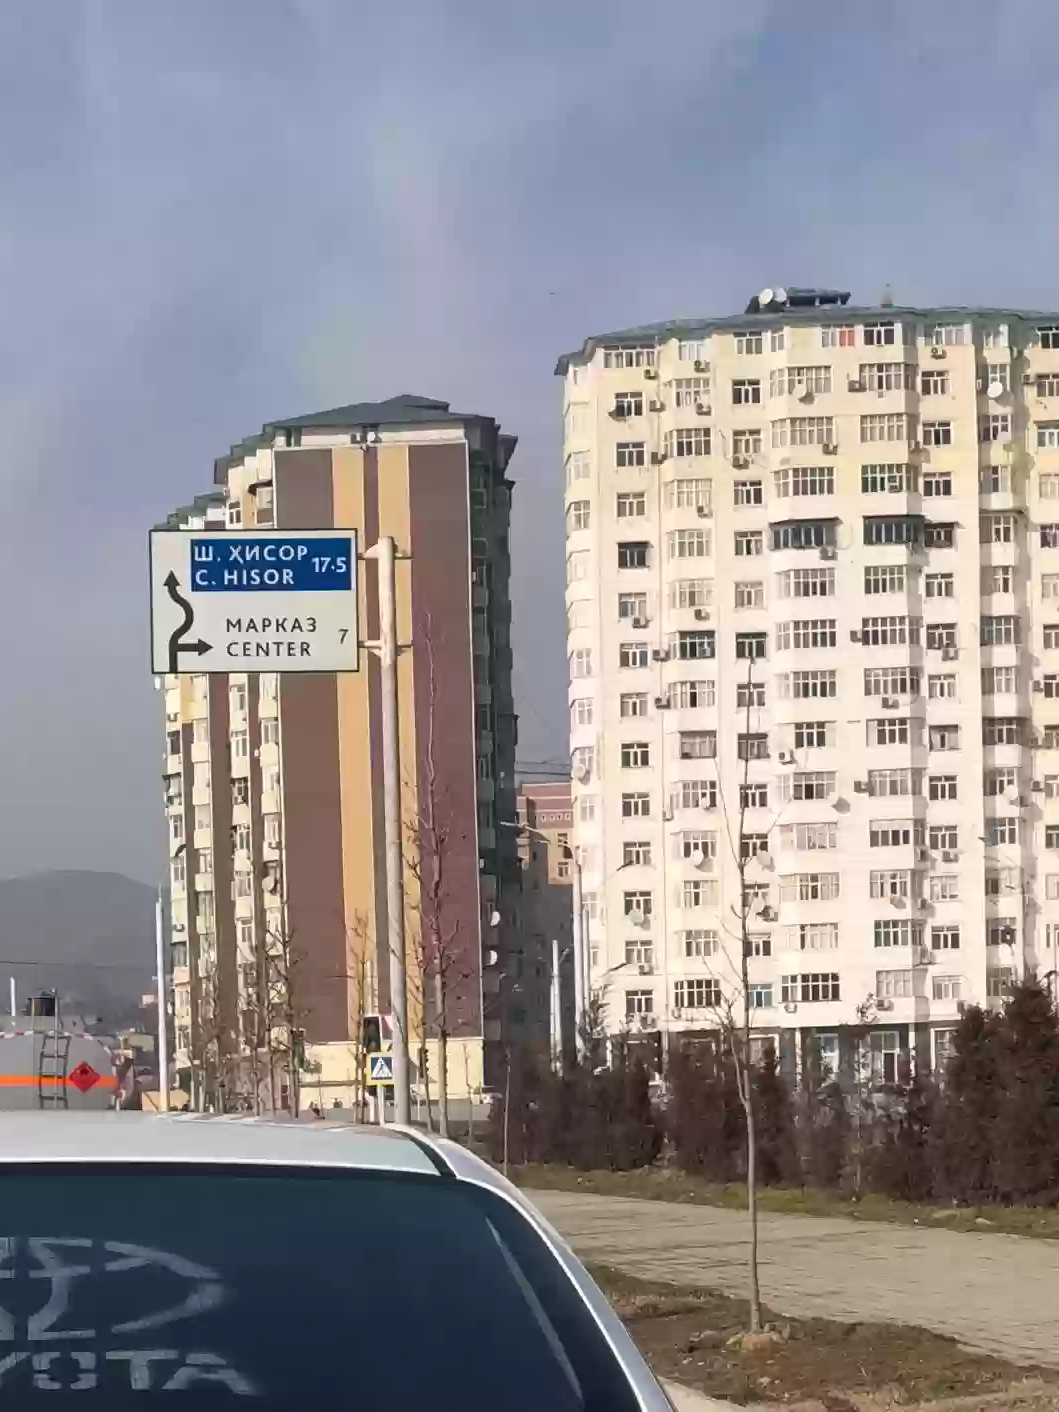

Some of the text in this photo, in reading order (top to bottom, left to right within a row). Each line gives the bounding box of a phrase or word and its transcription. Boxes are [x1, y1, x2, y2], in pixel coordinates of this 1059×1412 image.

[194, 545, 221, 562] Ш.
[195, 569, 295, 585] C. HISOR
[226, 617, 317, 633] МАРКАЗ
[338, 628, 349, 645] 7
[226, 641, 311, 657] CENTER
